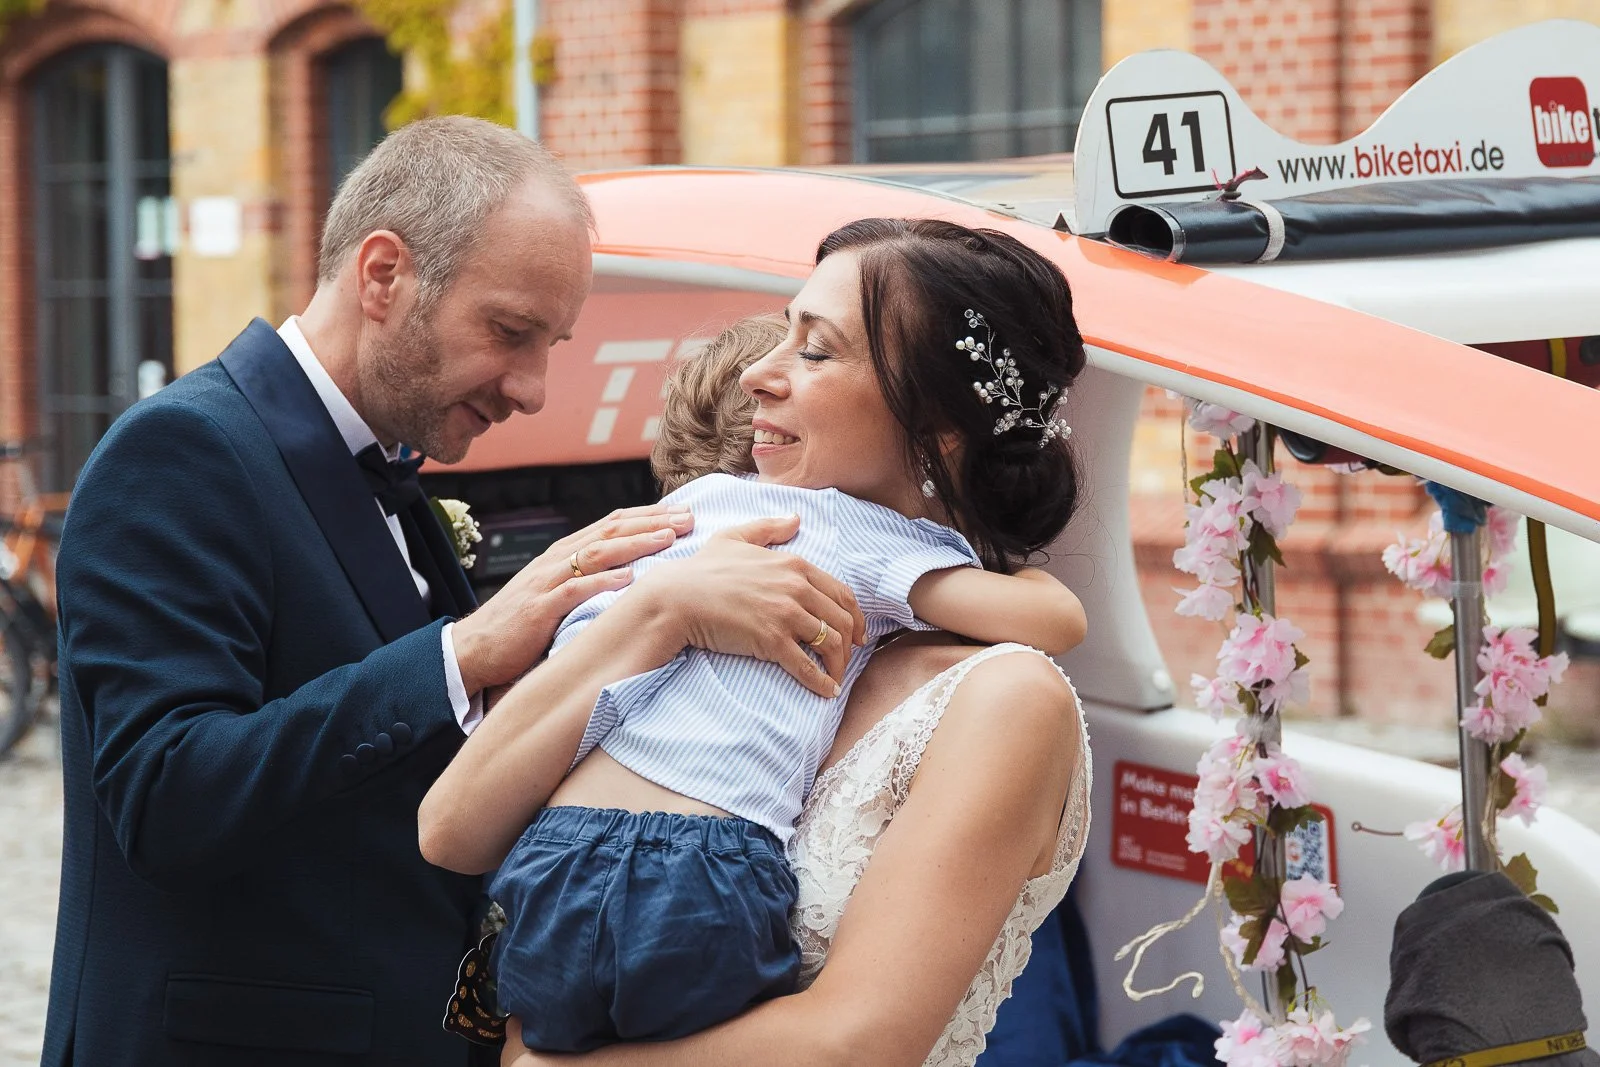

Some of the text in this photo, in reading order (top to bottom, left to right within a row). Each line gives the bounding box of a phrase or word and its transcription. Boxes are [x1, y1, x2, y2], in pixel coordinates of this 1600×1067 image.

[1142, 110, 1206, 176] 41
[1533, 100, 1590, 145] bike
[1277, 138, 1505, 184] www.biketaxi.de
[1120, 770, 1168, 797] Make
[1120, 793, 1187, 825] in Berlin
